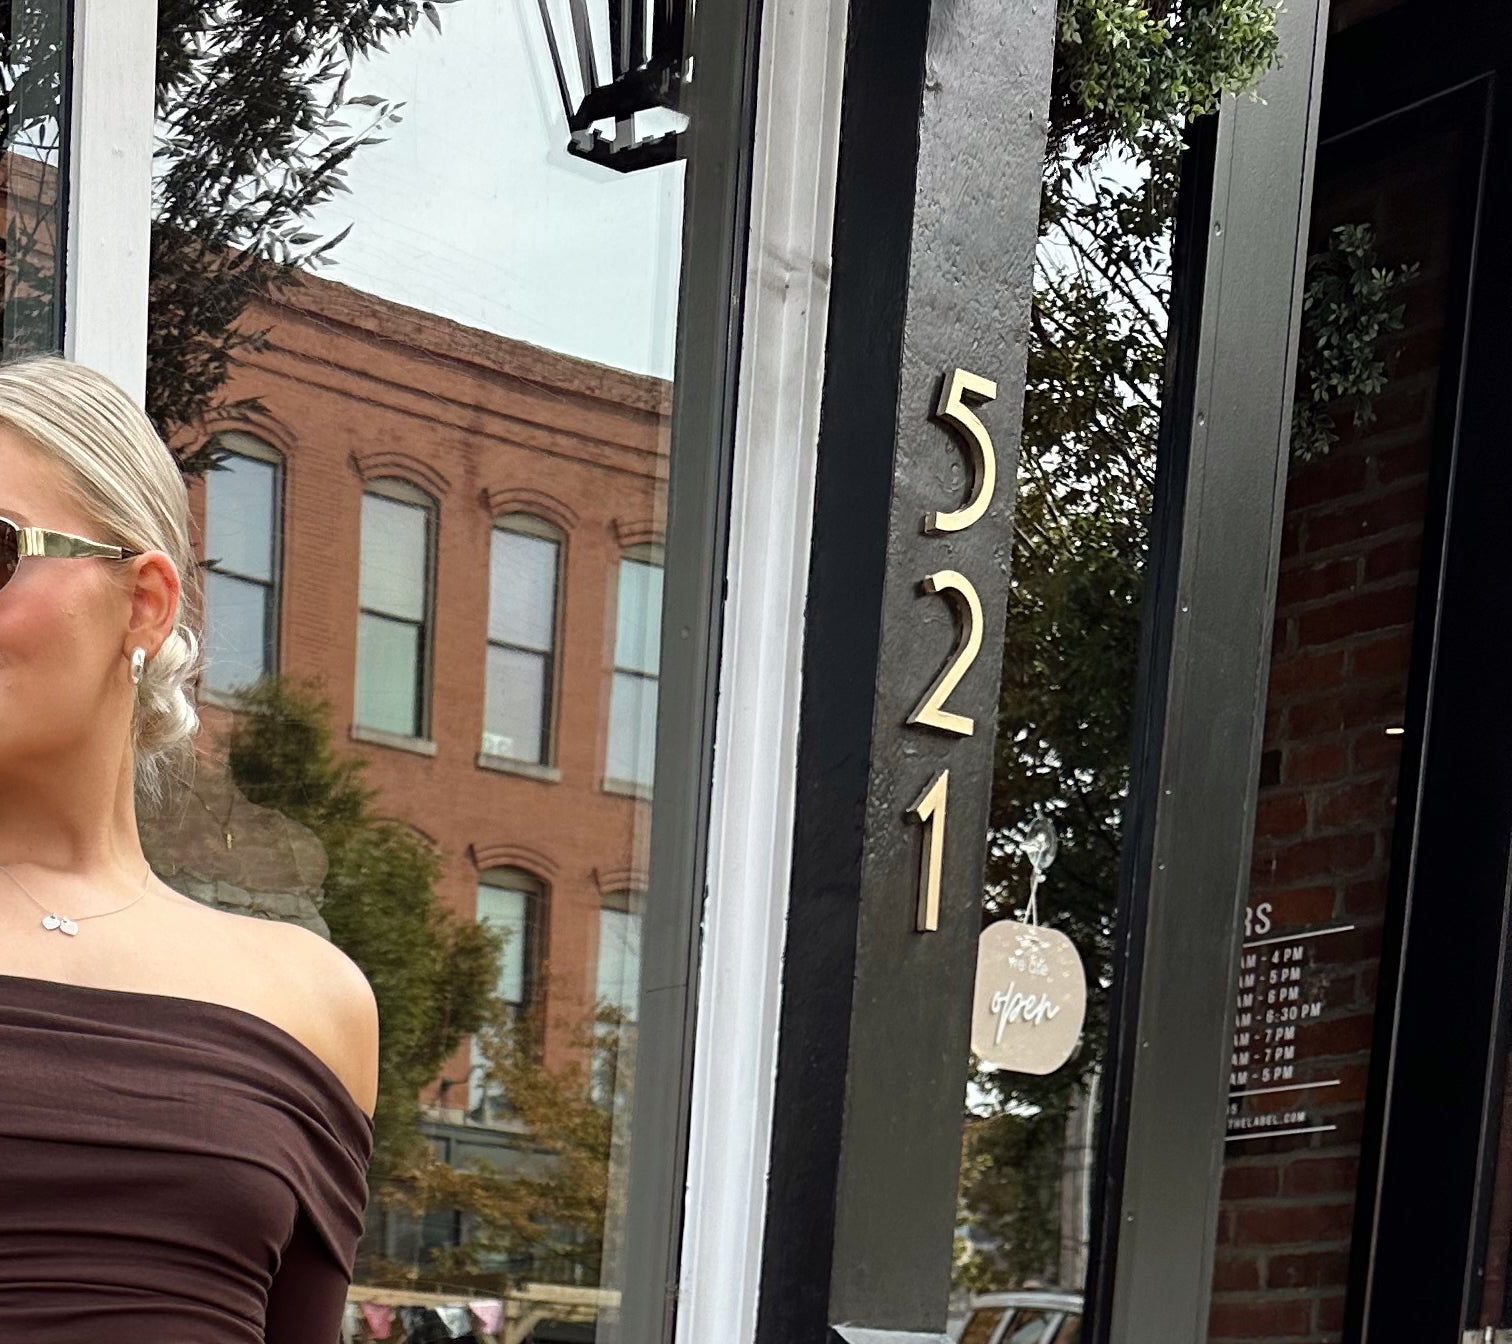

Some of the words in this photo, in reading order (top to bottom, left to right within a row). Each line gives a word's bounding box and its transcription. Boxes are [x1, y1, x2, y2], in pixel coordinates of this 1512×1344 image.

[906, 366, 999, 933] 521
[1271, 949, 1280, 964] 4
[1283, 945, 1304, 963] PM
[1269, 969, 1278, 984] 5
[1280, 966, 1301, 983] PM
[1267, 989, 1276, 1004] 6
[1279, 985, 1300, 1002] PM
[990, 981, 1061, 1045] open
[1266, 1006, 1298, 1024] 6:30
[1301, 1001, 1322, 1019] PM
[1264, 1028, 1272, 1043] 7
[1275, 1025, 1296, 1042] PM
[1264, 1048, 1272, 1063] 7
[1274, 1044, 1295, 1061] PM
[1273, 1064, 1294, 1081] PM
